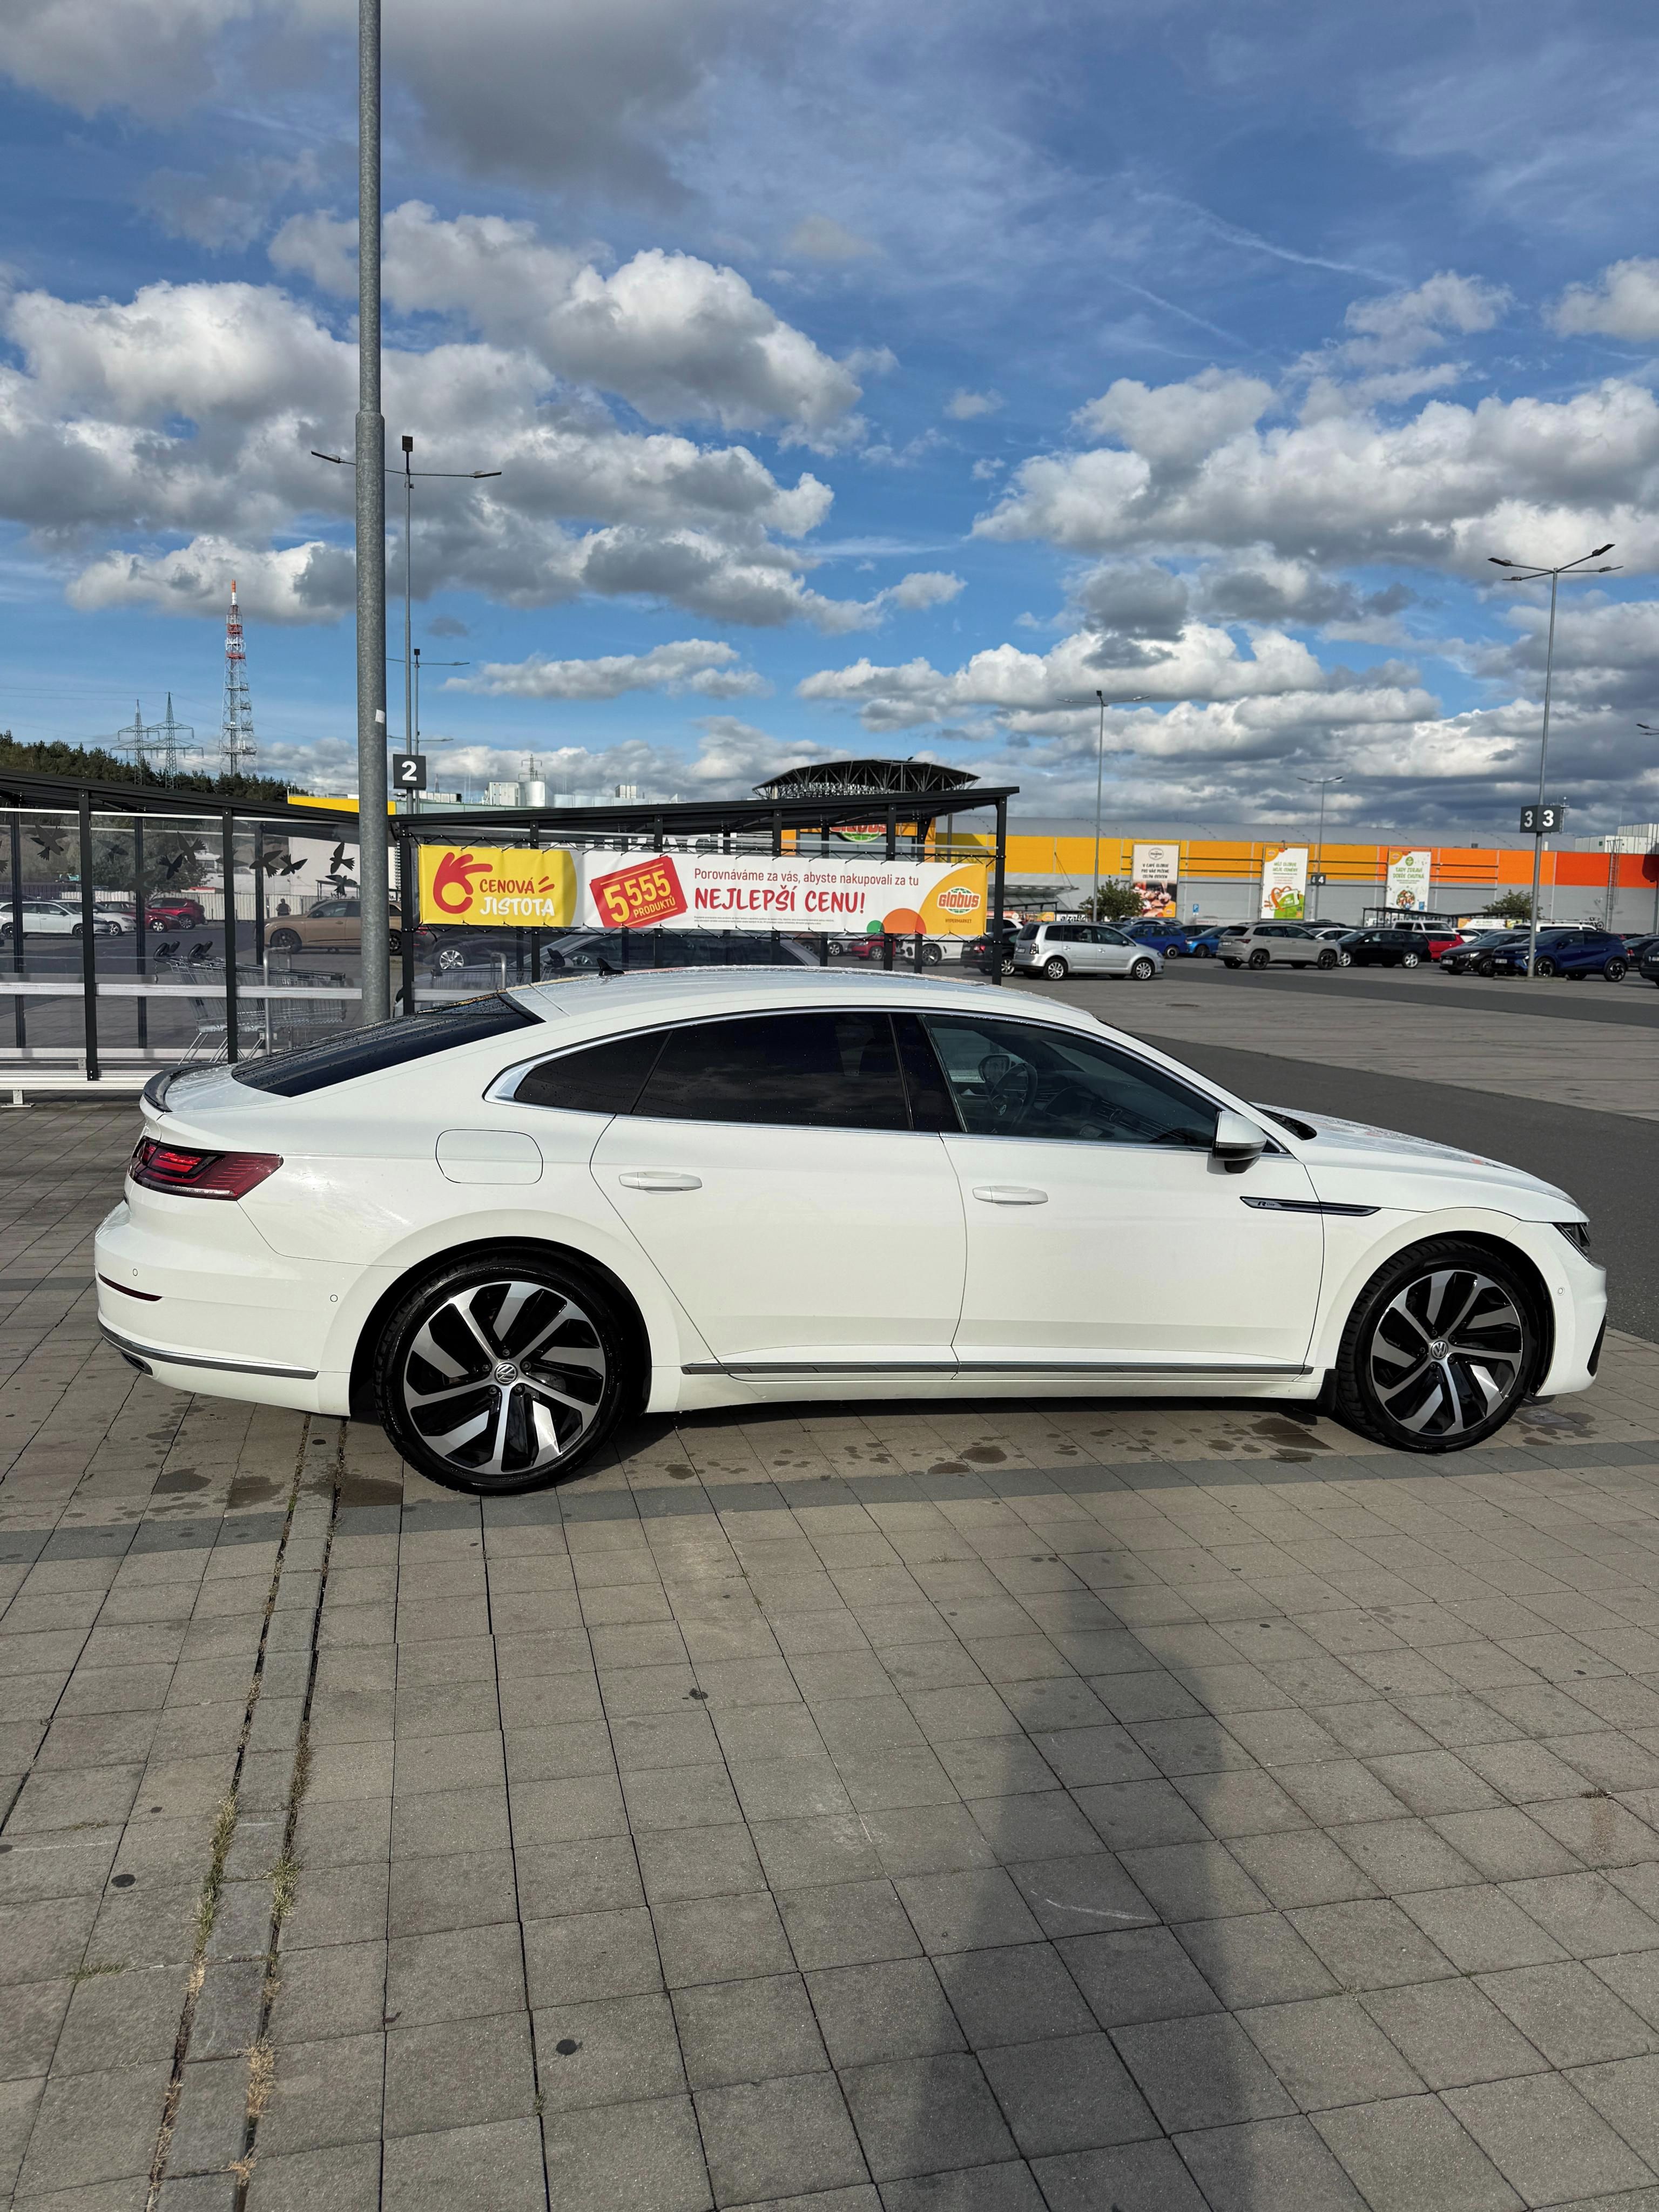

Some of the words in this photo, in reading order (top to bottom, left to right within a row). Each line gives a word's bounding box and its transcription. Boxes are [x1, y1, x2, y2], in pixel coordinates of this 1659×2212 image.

[402, 761, 417, 781] 2
[1524, 811, 1533, 827] 3
[1542, 810, 1554, 827] 3
[480, 877, 535, 894] CENOVÁ
[694, 868, 764, 881] Porovnáváme
[767, 873, 778, 881] za
[781, 871, 800, 884] vás,
[804, 872, 837, 885] abyste
[840, 873, 892, 886] nakupovali
[895, 877, 905, 885] za
[909, 876, 919, 886] tu
[480, 896, 555, 916] JISTOTA
[603, 870, 671, 922] 5555
[695, 885, 797, 912] NEJLEPŠÍ
[805, 891, 865, 913] CENU!
[633, 895, 676, 918] PRODUKTŮ
